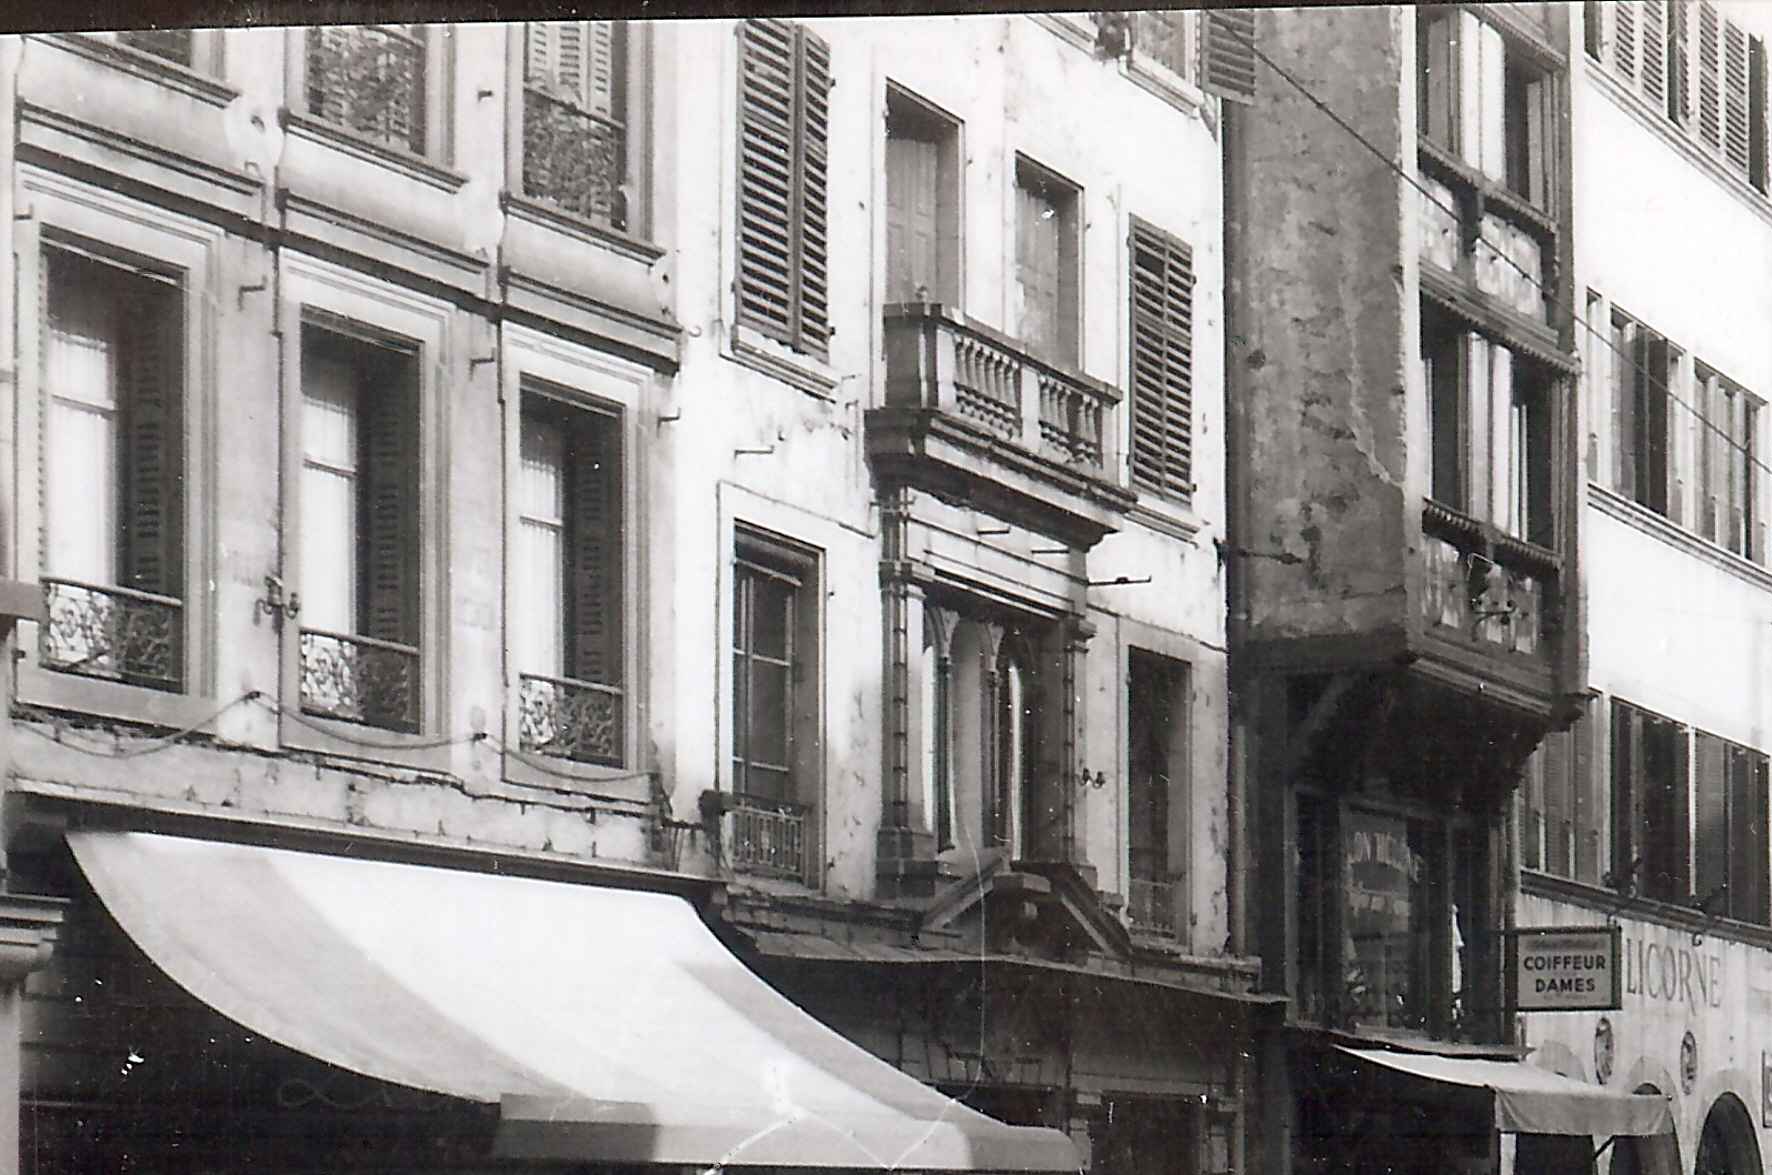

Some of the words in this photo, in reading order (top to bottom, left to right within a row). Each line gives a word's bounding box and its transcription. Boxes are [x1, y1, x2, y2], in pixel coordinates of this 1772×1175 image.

[1523, 955, 1607, 972] COIFFEUR
[1535, 977, 1596, 993] DAMES
[1626, 938, 1721, 1016] LICORNE
